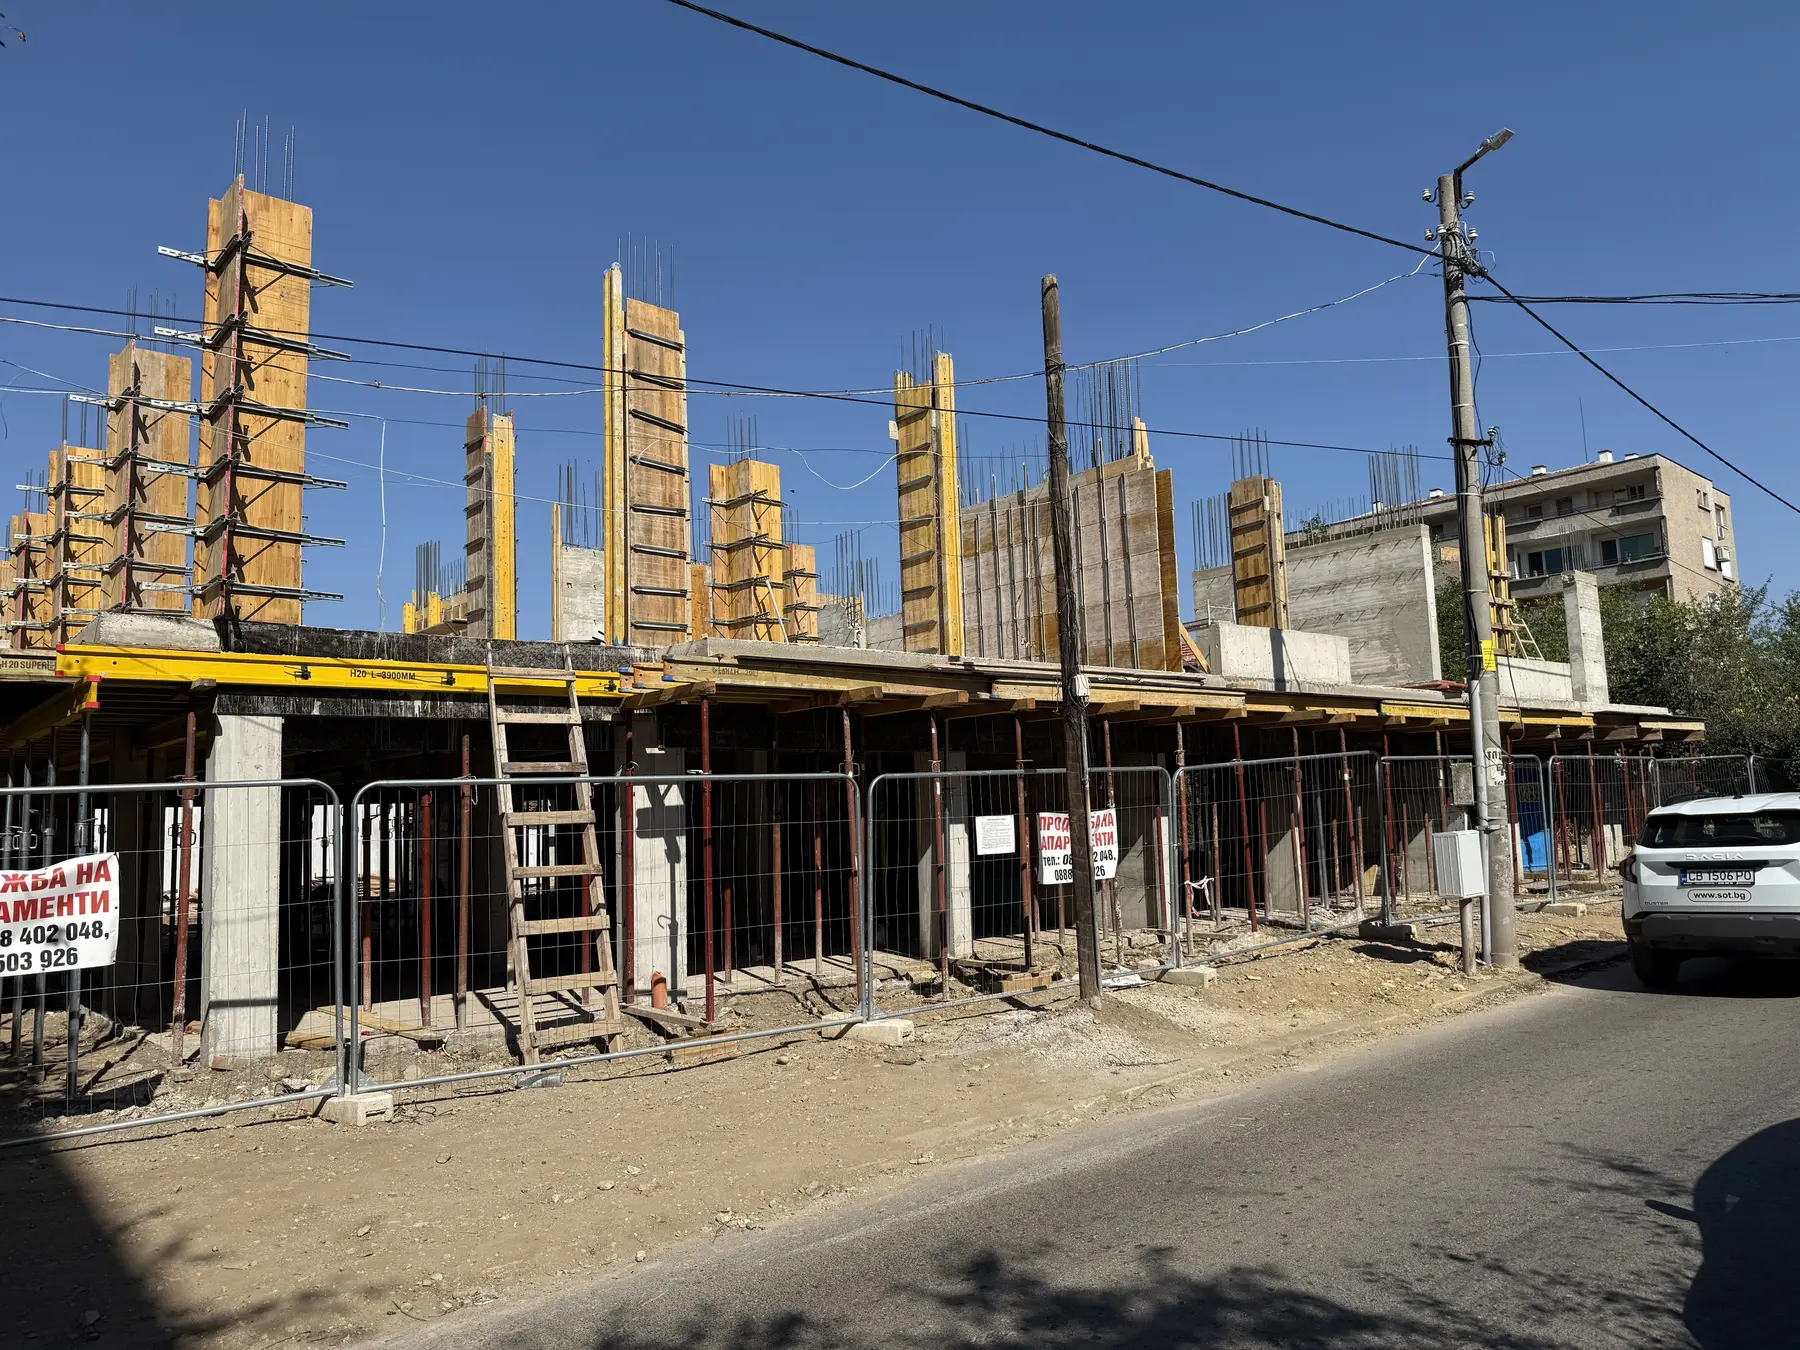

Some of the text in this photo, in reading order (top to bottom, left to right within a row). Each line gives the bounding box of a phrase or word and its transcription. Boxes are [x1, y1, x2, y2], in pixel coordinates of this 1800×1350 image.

[9, 660, 19, 669] 20
[20, 660, 47, 670] SUPER
[350, 669, 367, 678] H20
[1685, 852, 1744, 860] DACIA
[1043, 856, 1060, 867] тел.:
[76, 860, 111, 885] НА
[1688, 871, 1704, 881] CB
[1707, 871, 1734, 881] 1506
[1693, 891, 1746, 900] www.sot.bg
[19, 924, 59, 945] 402
[65, 920, 110, 941] 048,
[40, 947, 78, 969] 926
